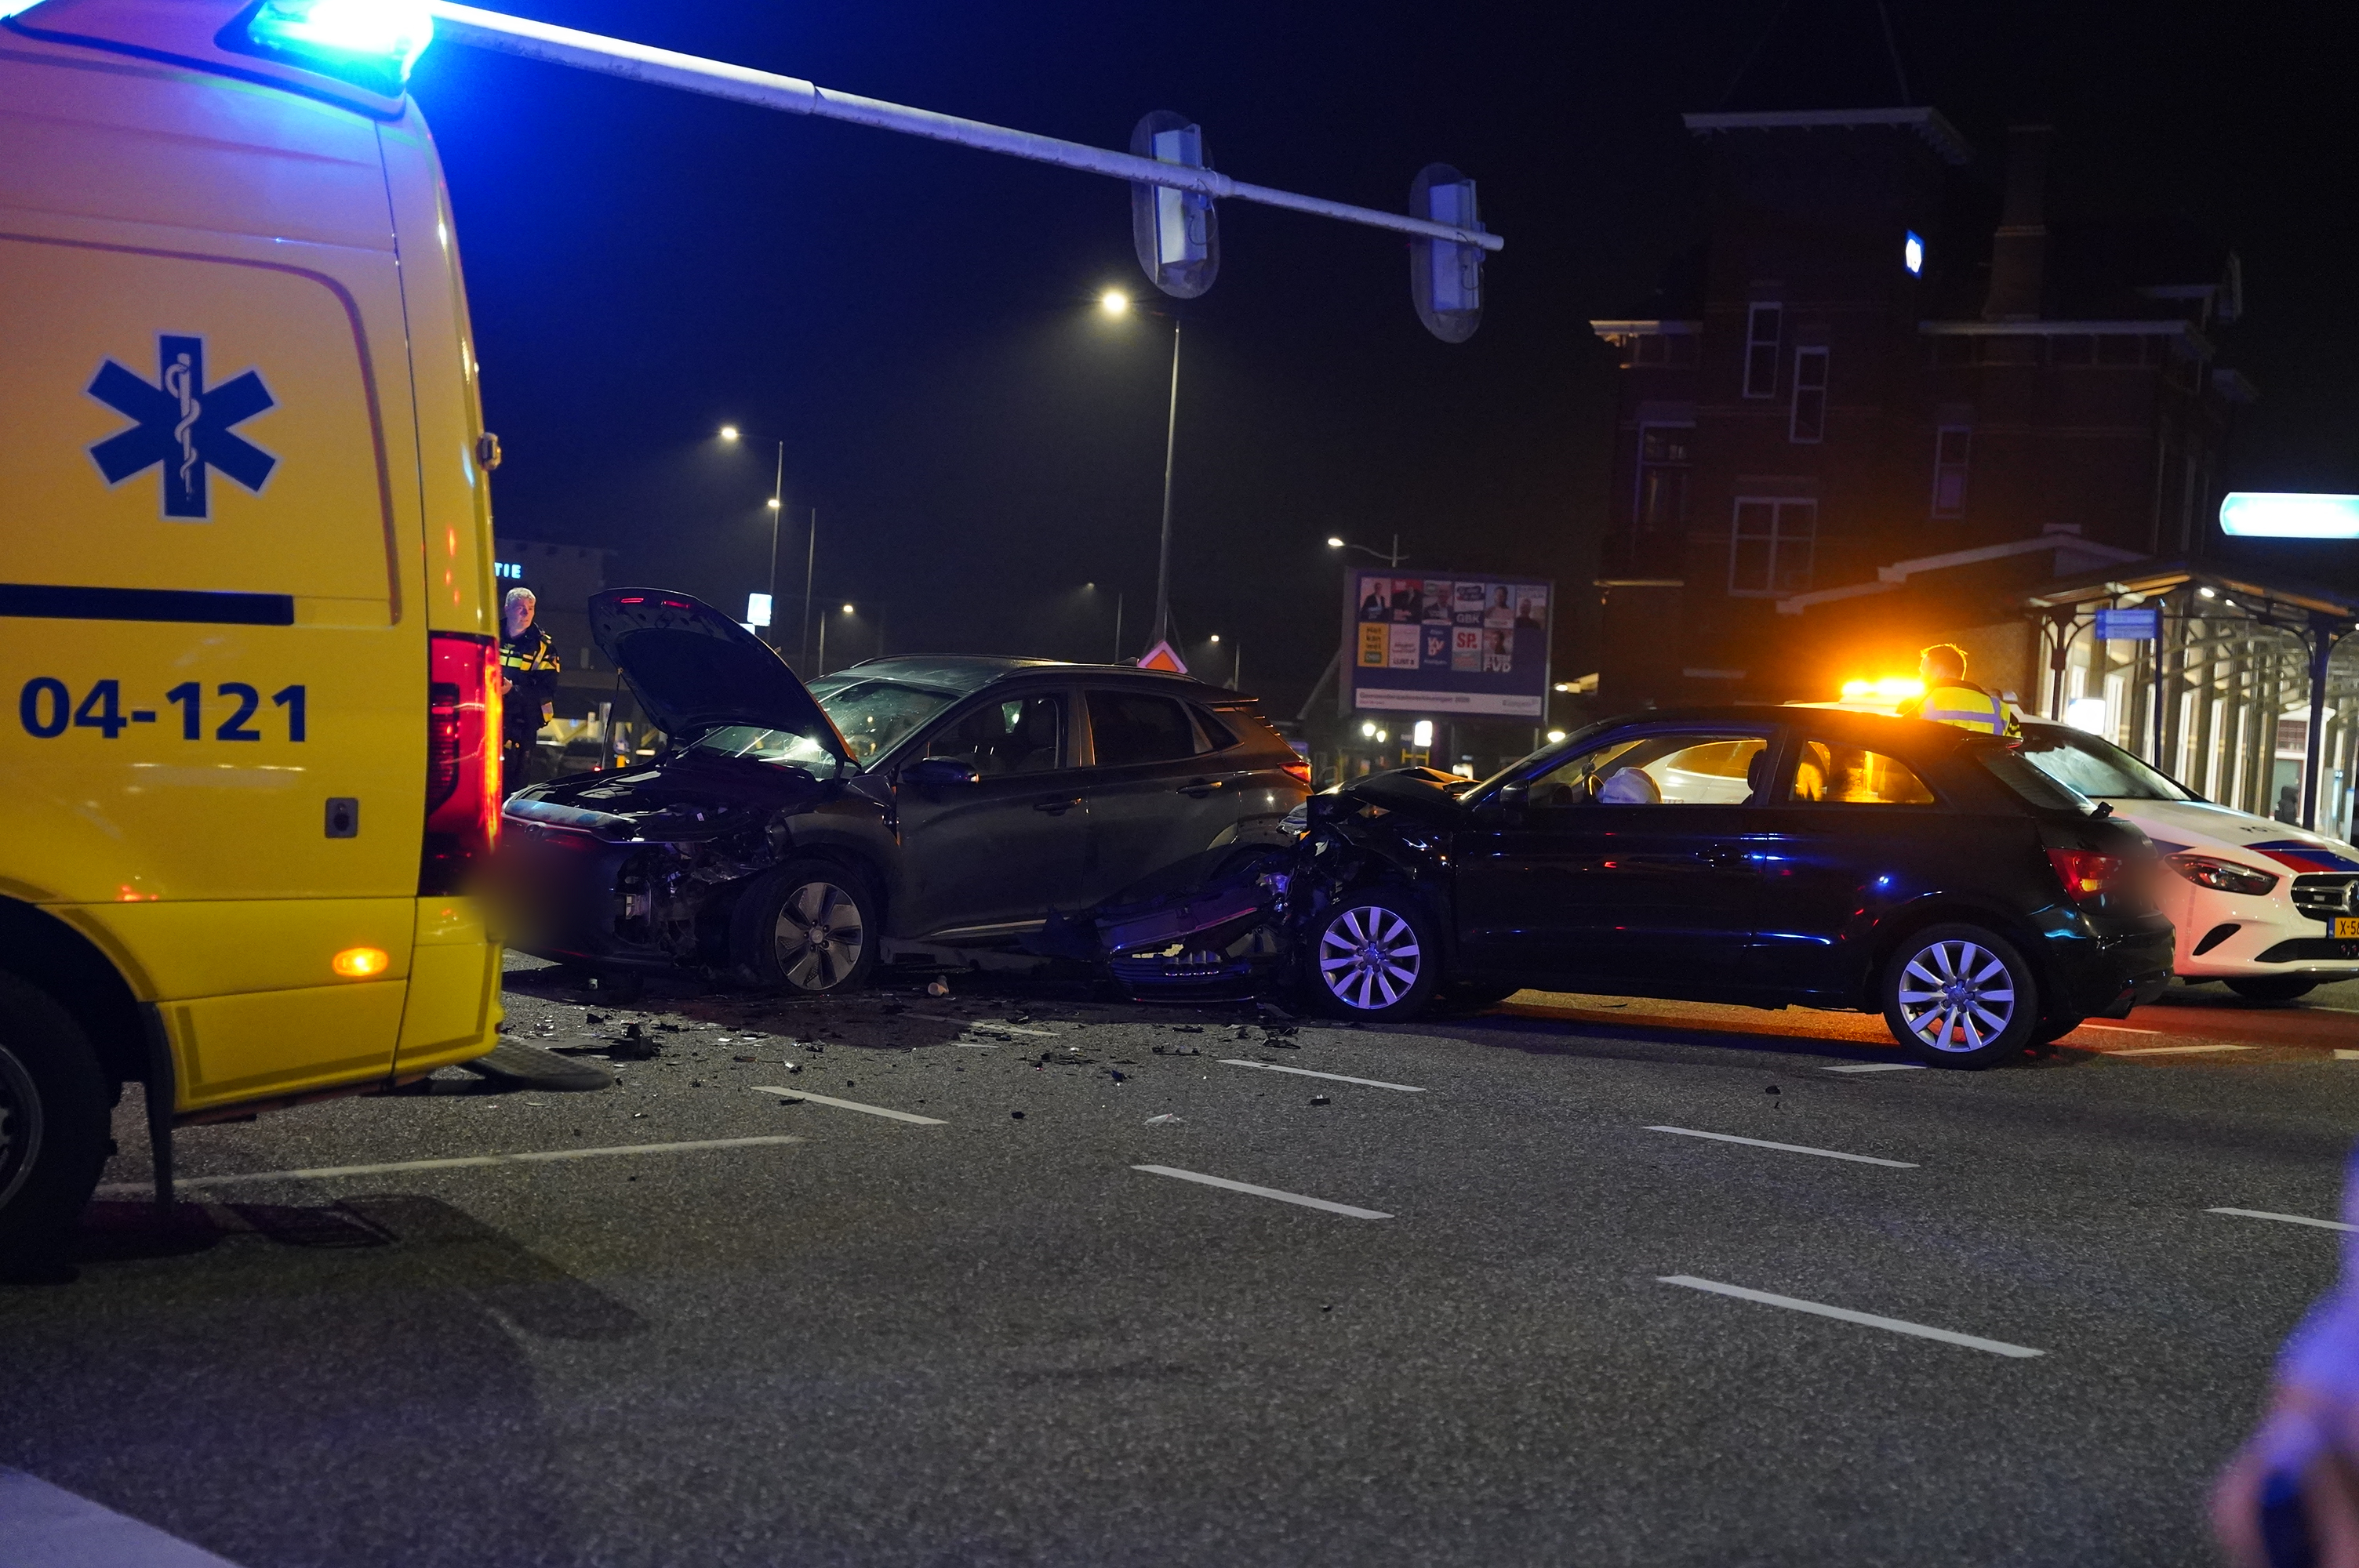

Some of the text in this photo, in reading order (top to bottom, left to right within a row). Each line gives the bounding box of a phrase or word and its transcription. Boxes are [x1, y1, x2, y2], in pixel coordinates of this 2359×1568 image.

[495, 562, 521, 579] TIE
[1456, 613, 1480, 624] GBK
[19, 676, 307, 743] 04-121
